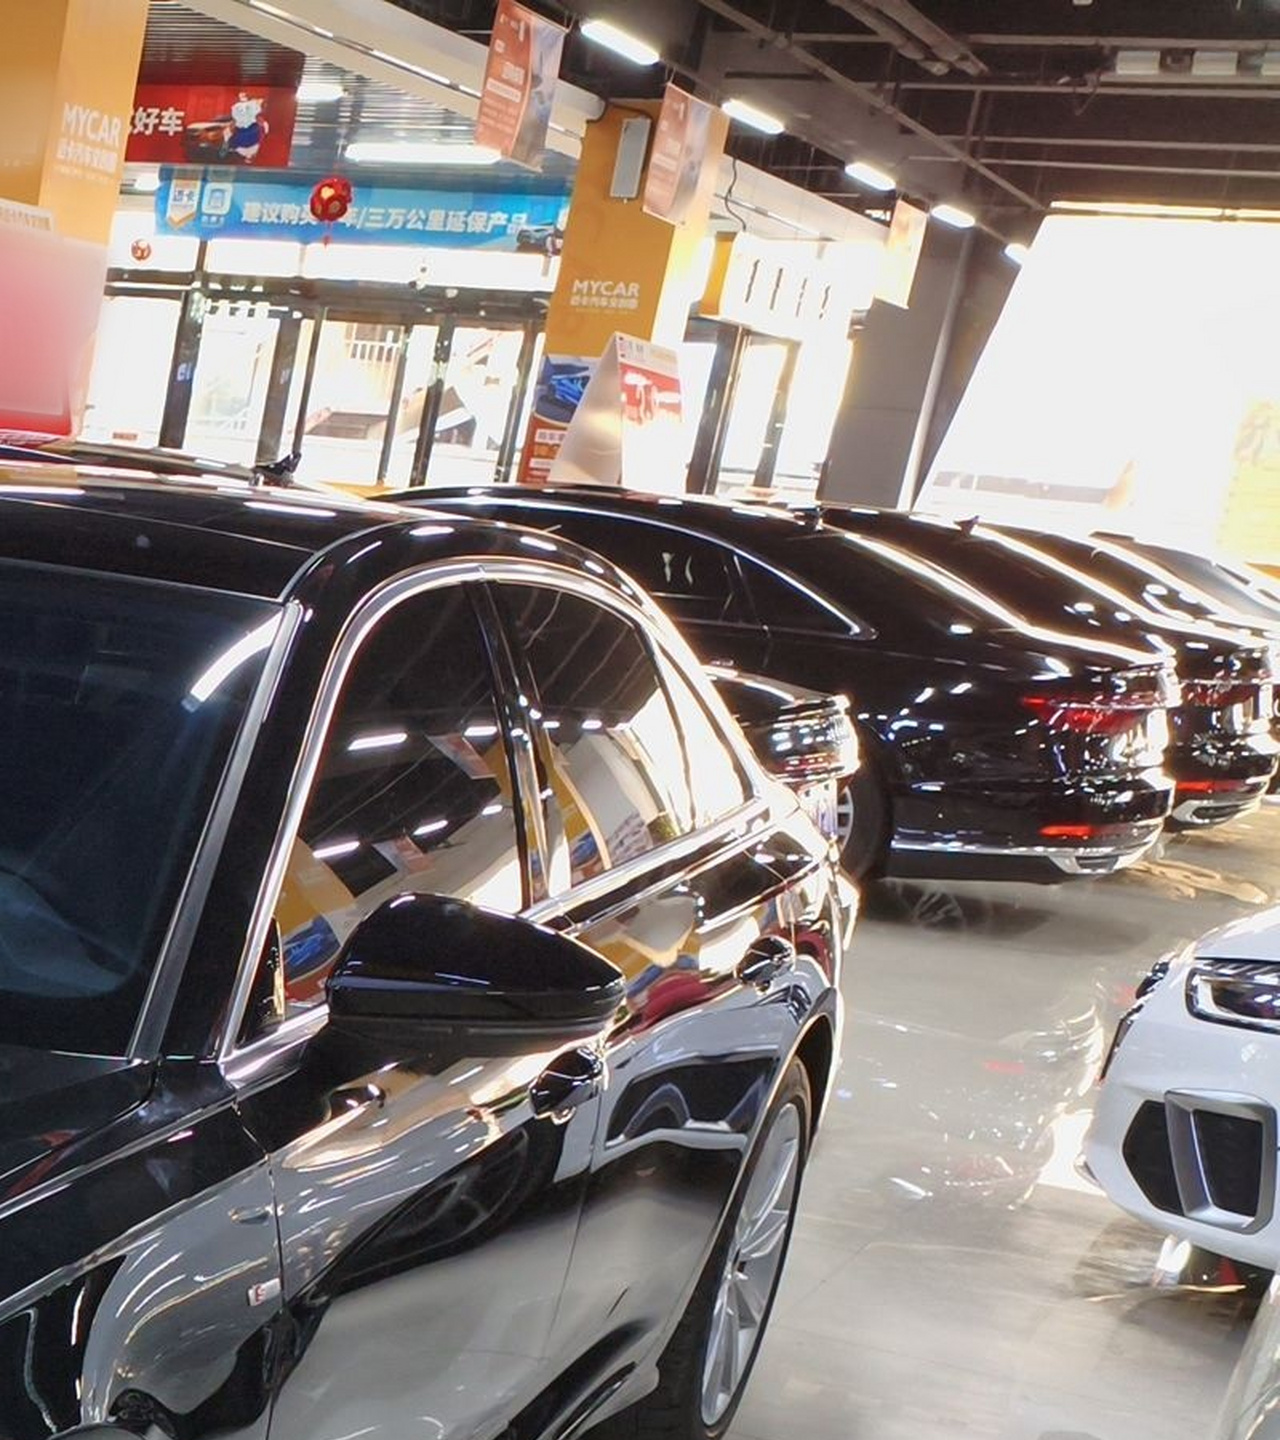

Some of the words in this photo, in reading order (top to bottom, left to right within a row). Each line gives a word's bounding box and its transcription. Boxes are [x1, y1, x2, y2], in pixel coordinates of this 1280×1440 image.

[60, 101, 122, 149] MYCAR
[130, 107, 185, 136] 好车
[571, 279, 640, 297] MYCAR
